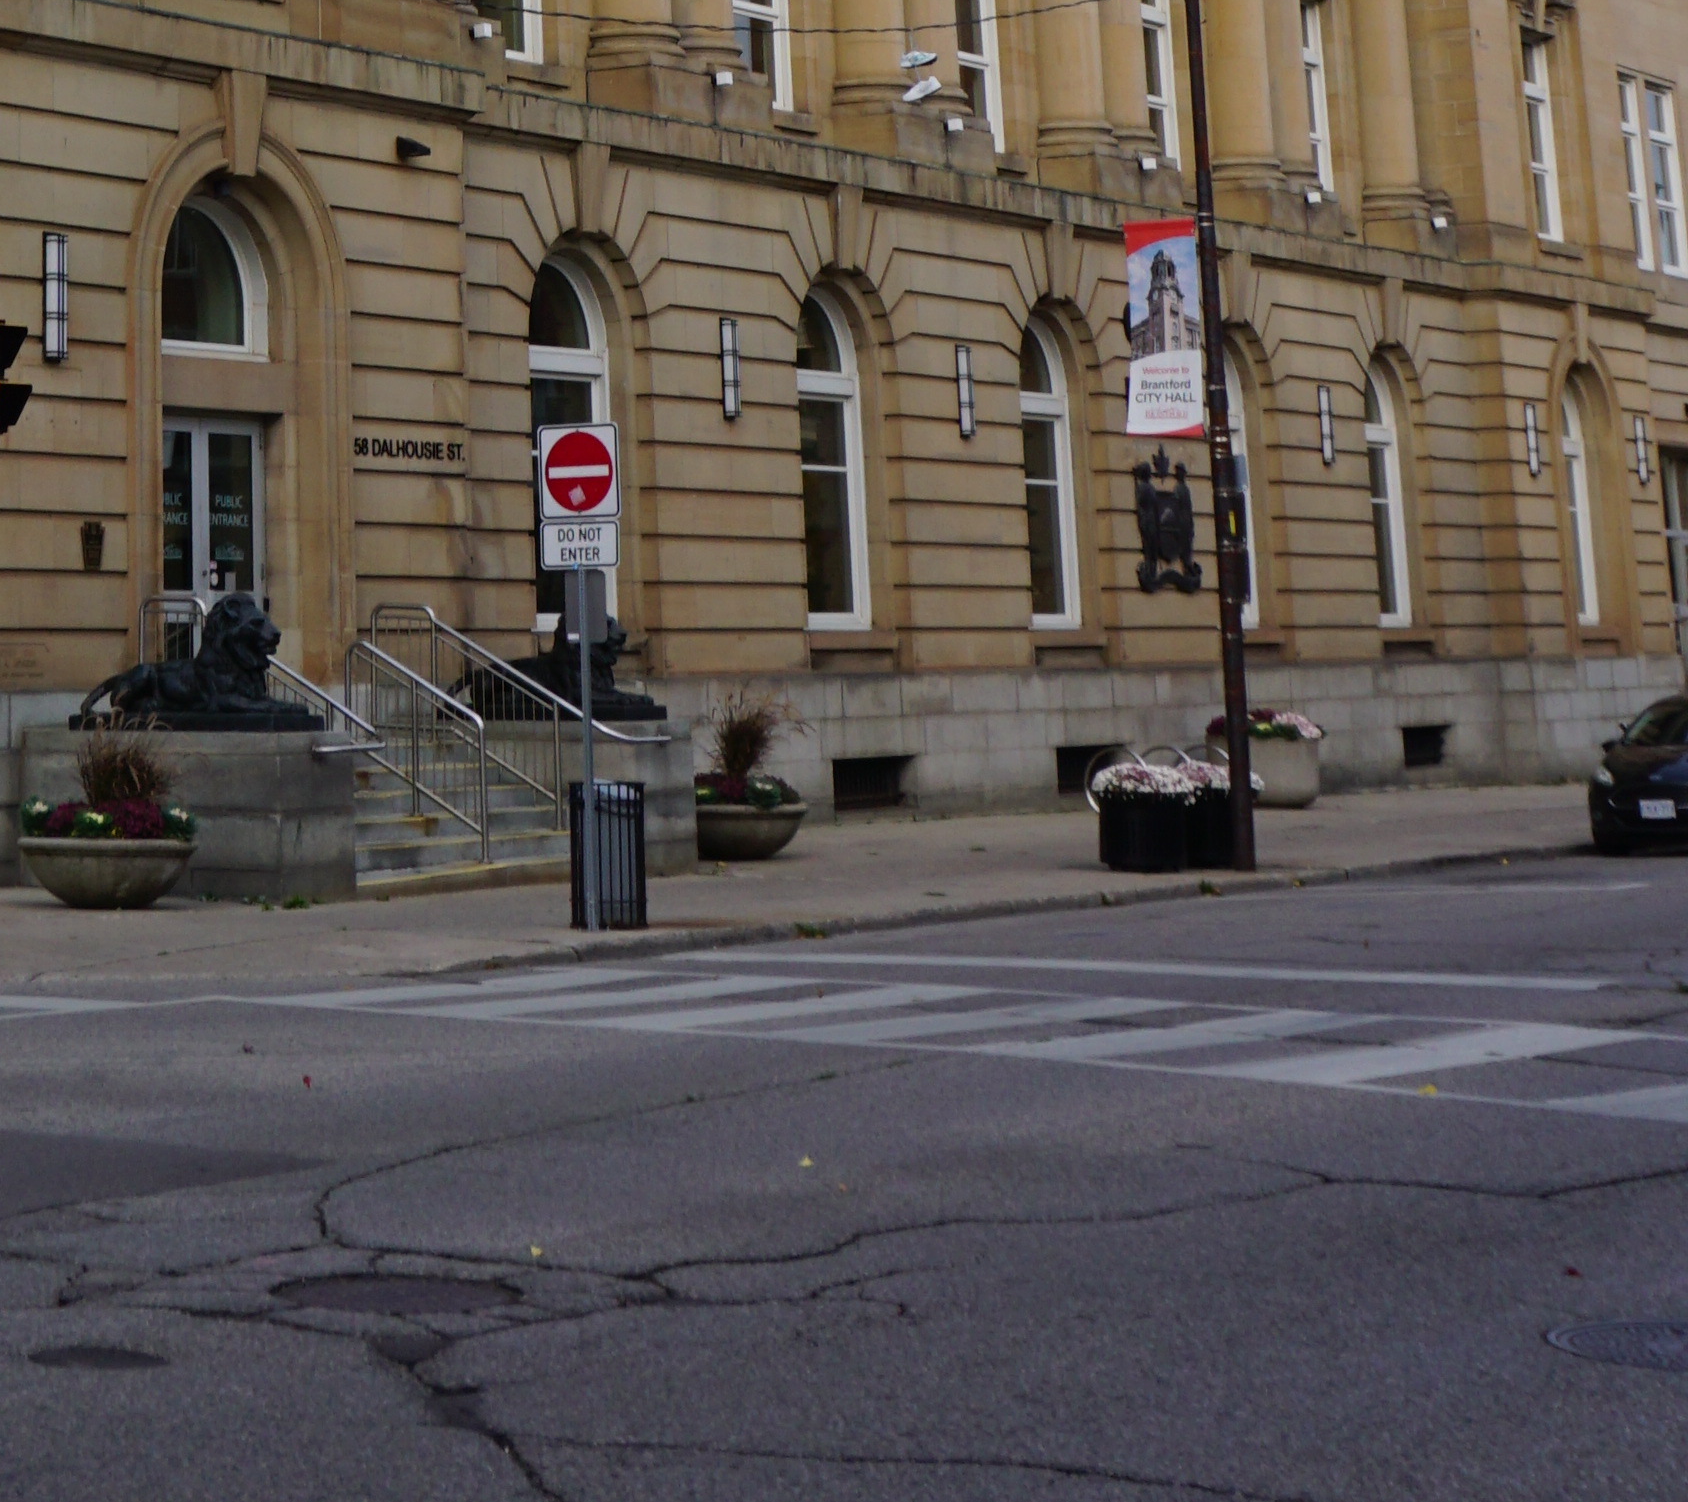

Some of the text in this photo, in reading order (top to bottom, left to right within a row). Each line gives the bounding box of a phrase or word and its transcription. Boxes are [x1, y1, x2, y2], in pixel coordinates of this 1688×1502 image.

[1142, 366, 1190, 375] Welcome to
[1140, 379, 1191, 390] Brantford
[1135, 392, 1197, 403] CITY HALL
[354, 437, 466, 462] 58 DALHOUSIE ST.
[215, 494, 243, 509] PUBLIC
[557, 527, 601, 542] DO NOT
[560, 546, 600, 562] ENTER
